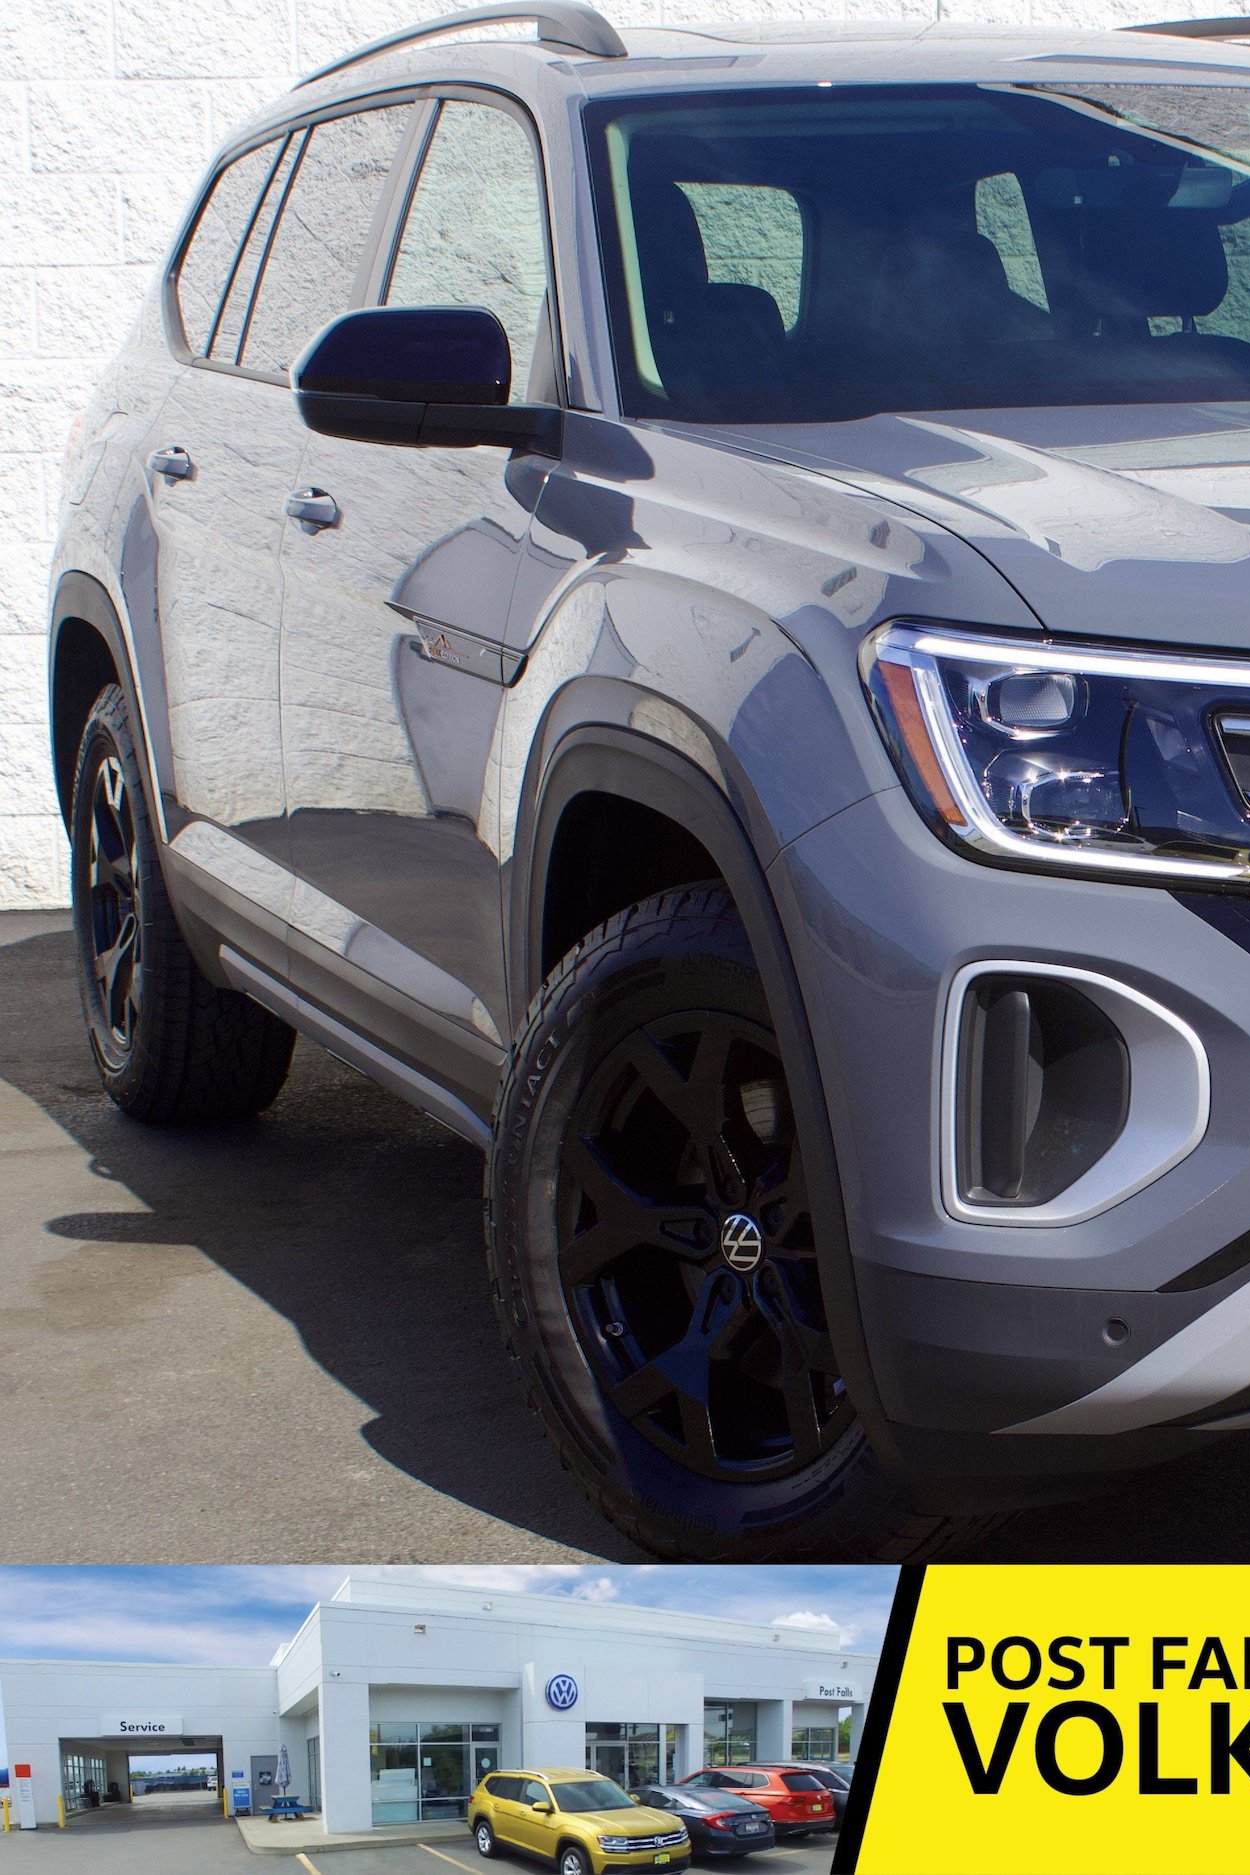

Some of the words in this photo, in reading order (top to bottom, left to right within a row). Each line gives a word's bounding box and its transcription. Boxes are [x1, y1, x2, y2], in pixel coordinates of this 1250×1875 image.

[819, 1685, 835, 1697] Post
[836, 1686, 853, 1698] Falls
[120, 1720, 165, 1733] Service
